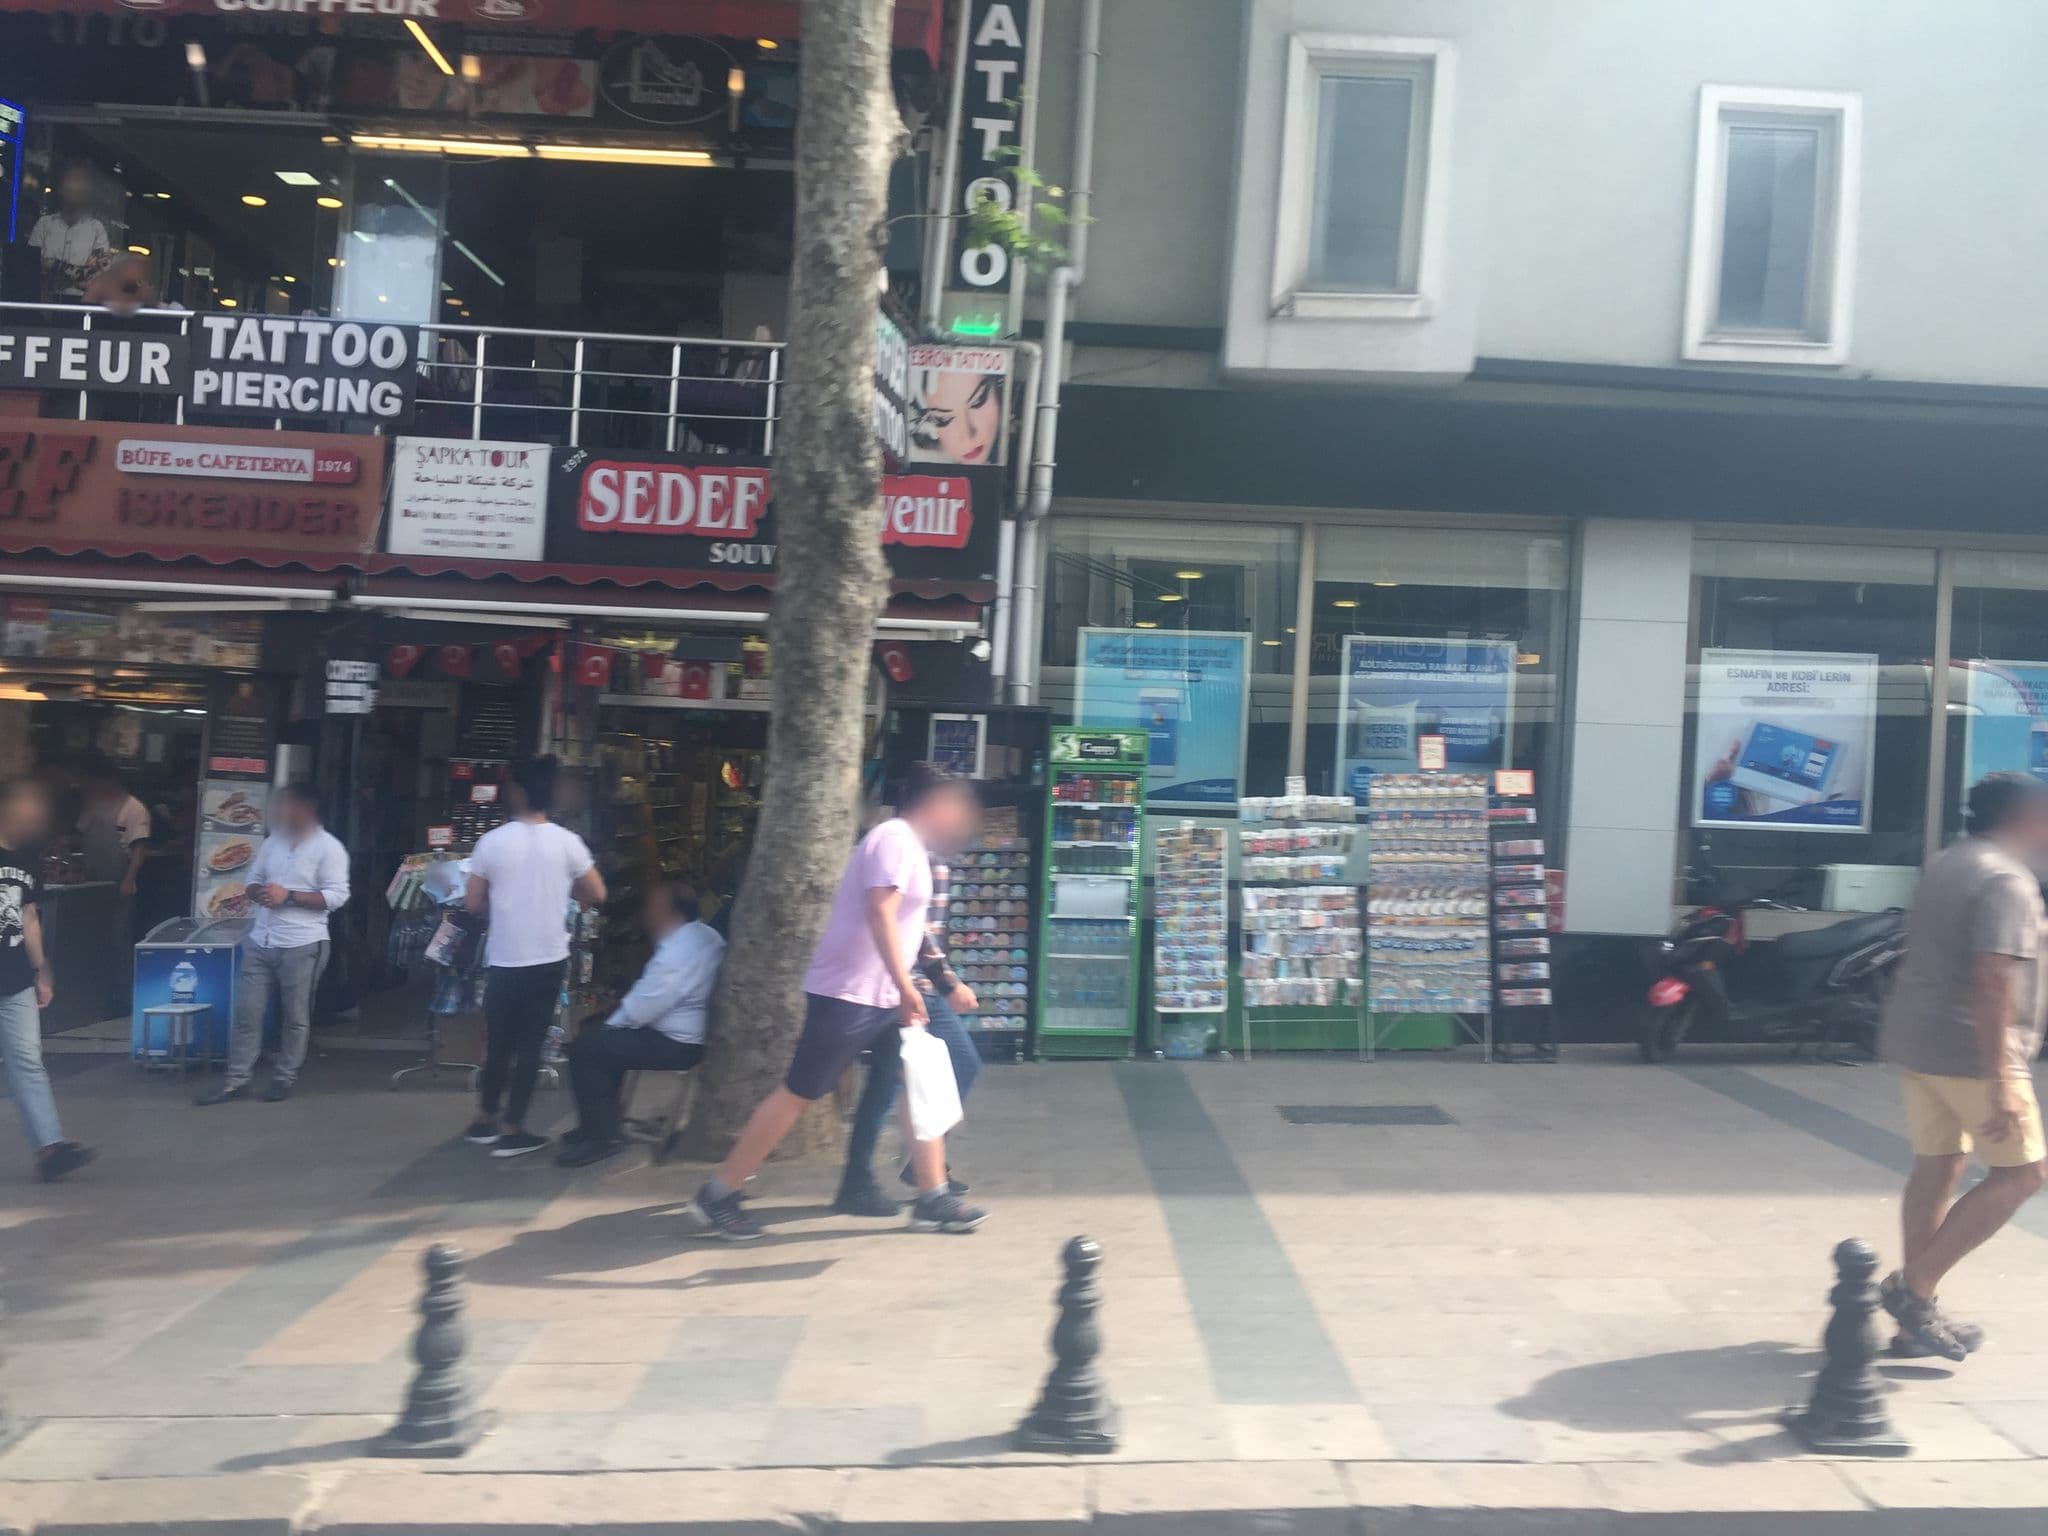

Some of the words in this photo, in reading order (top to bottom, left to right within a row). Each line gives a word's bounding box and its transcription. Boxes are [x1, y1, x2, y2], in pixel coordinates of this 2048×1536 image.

[203, 316, 408, 369] TATTOO
[193, 369, 403, 417] PIERCING
[121, 448, 172, 466] BÜFE
[199, 453, 309, 474] CAFETERYA
[316, 459, 352, 473] 1974
[480, 449, 530, 468] TOUR
[585, 468, 765, 530] SEDEF
